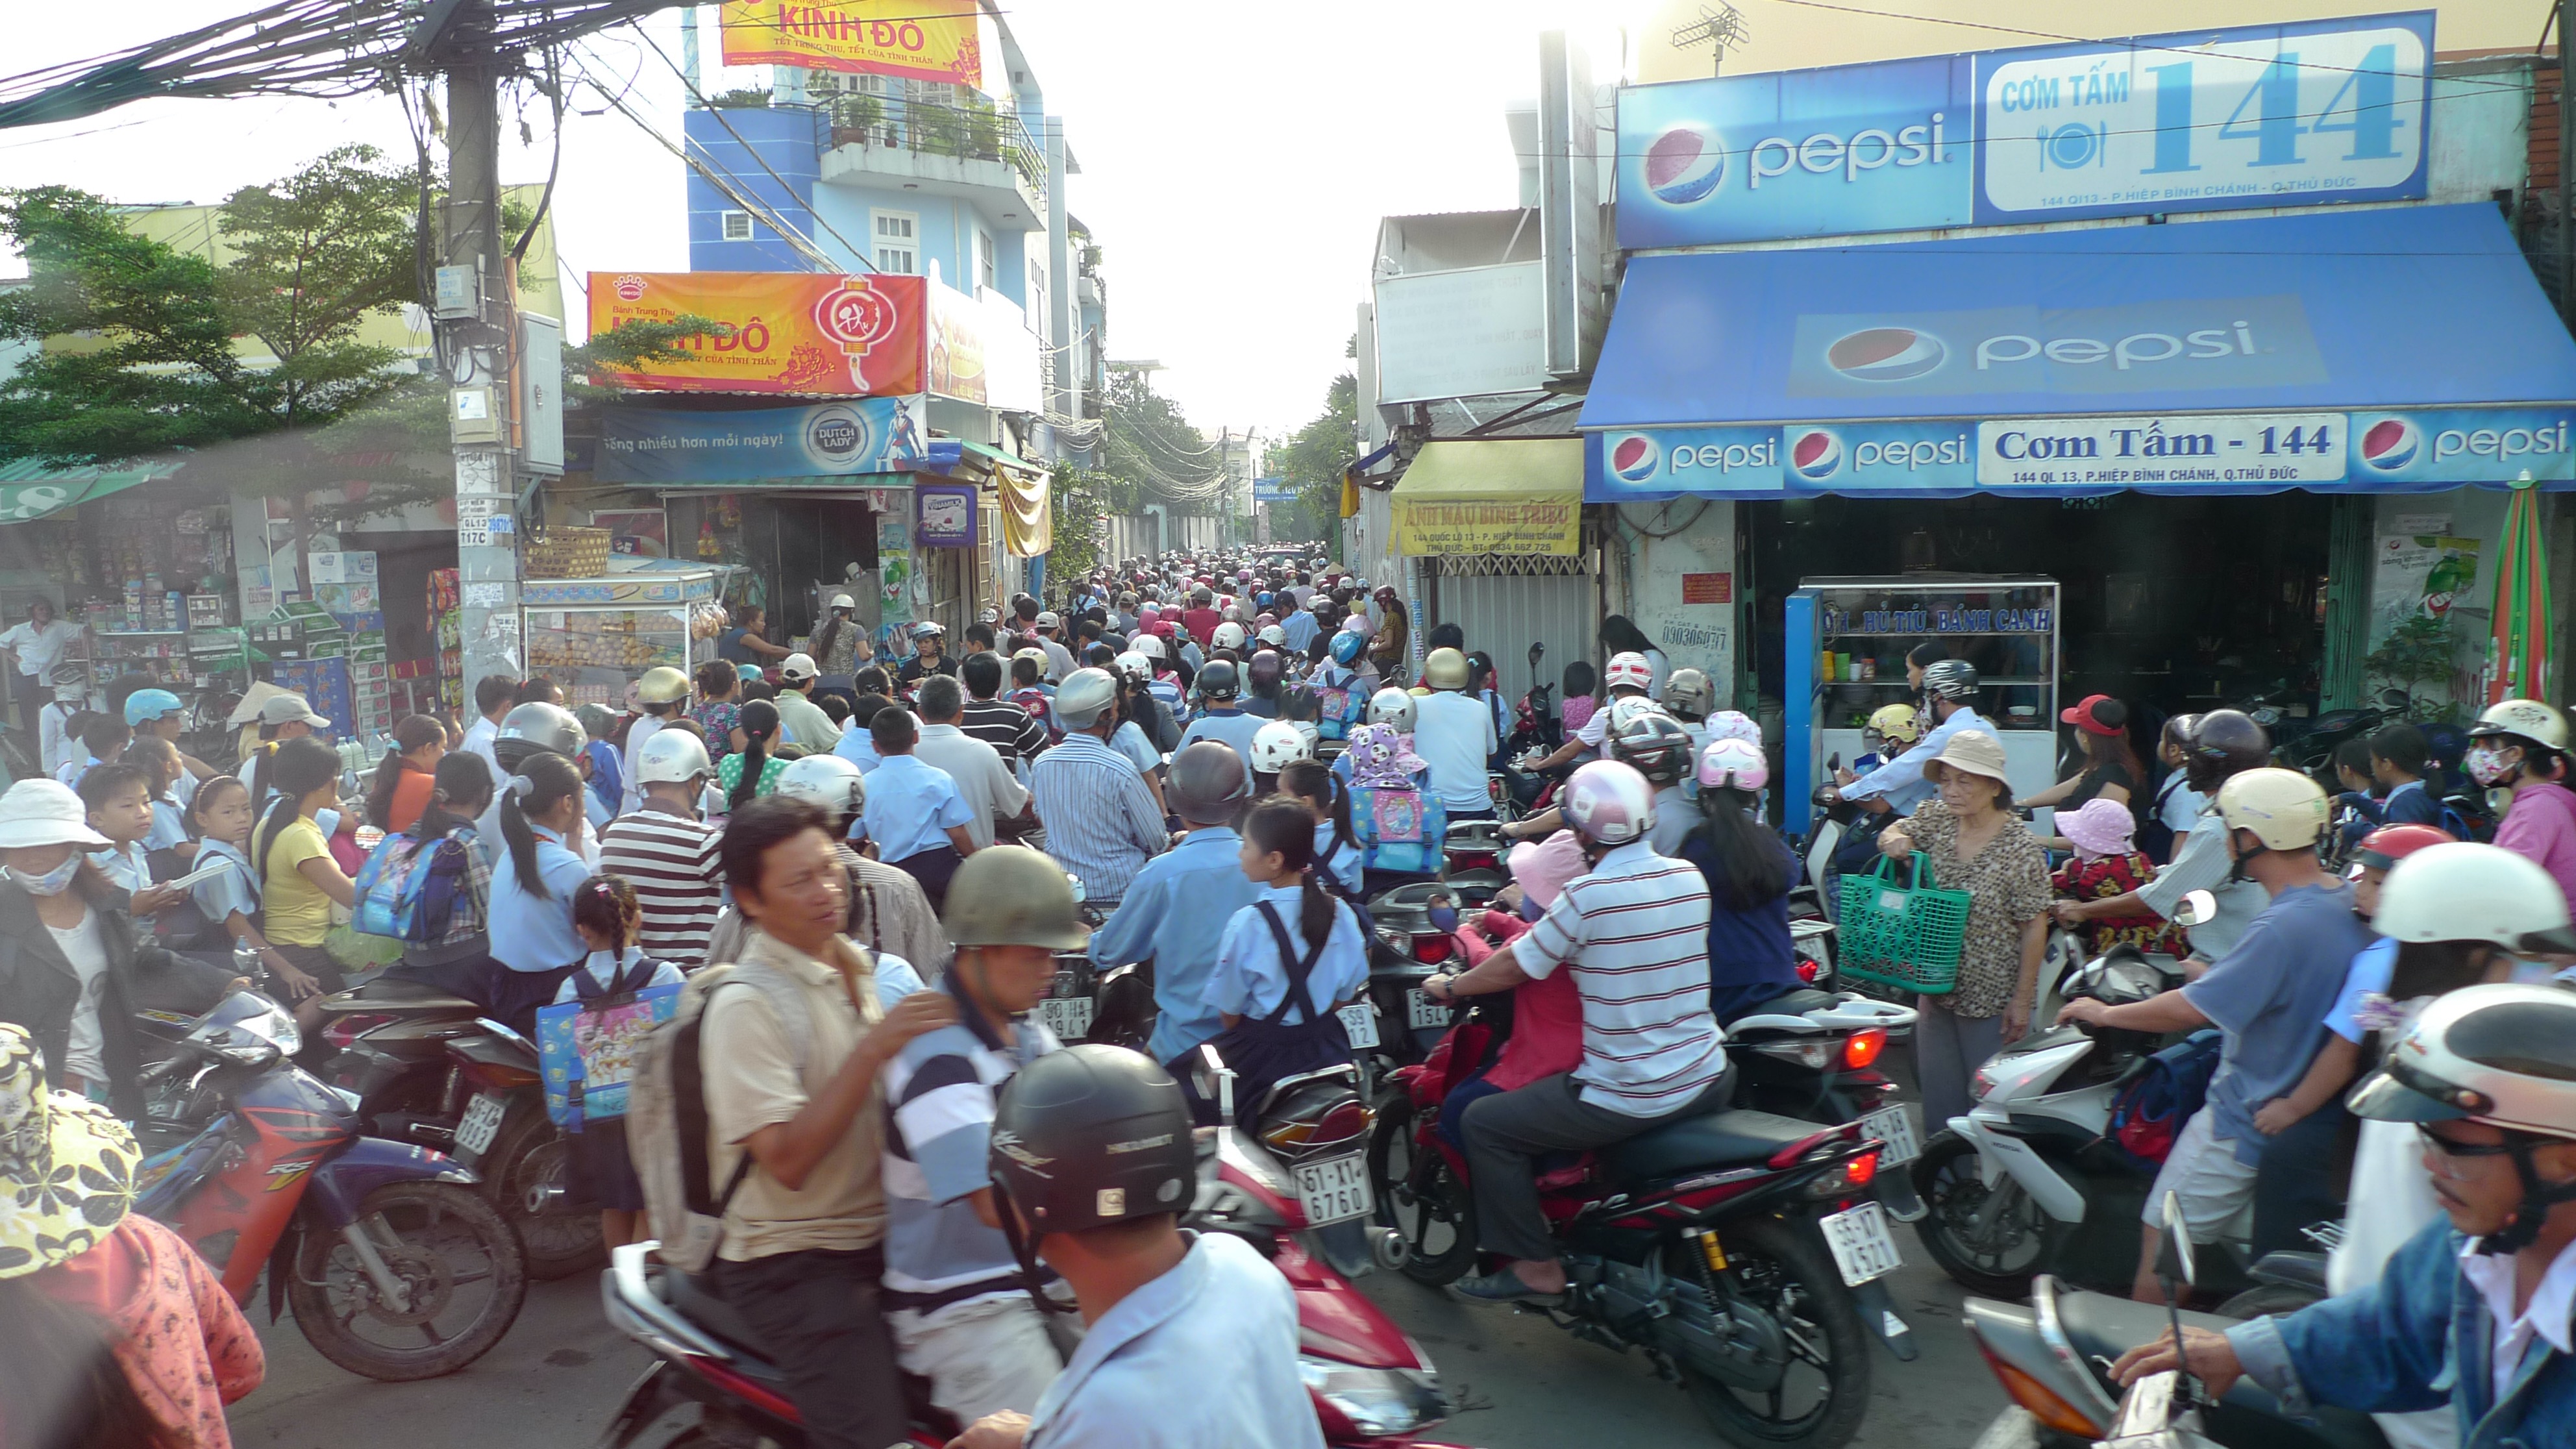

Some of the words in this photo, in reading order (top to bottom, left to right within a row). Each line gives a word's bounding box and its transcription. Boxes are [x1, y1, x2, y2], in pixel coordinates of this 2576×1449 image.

[779, 5, 863, 42] KINH
[870, 18, 924, 52] ĐÔ
[774, 37, 790, 46] TẾT
[793, 40, 823, 50] TRUNG
[825, 43, 845, 55] THU,
[848, 43, 865, 55] TẾT
[887, 50, 908, 62] TÌNH
[2000, 73, 2059, 113] CƠM
[2069, 60, 2129, 106] TẤM
[2140, 43, 2406, 175] 144
[1750, 112, 1944, 189] pepsi
[2040, 196, 2063, 207] 144
[2112, 189, 2160, 203] P.HIỆP
[2165, 186, 2199, 199] BÌNH
[2204, 182, 2257, 195] CHÁNH
[2323, 175, 2357, 188] ĐỨC
[613, 306, 633, 314] Bánh
[636, 307, 658, 317] Trung
[660, 308, 675, 316] Thu
[1977, 320, 2256, 370] pepsi
[705, 354, 724, 364] CỦA
[726, 355, 749, 365] TÌNH
[638, 433, 676, 449] nhiều
[680, 436, 708, 448] hơn
[713, 432, 739, 447] mỗi
[743, 433, 783, 449] ngày!
[819, 427, 855, 440] DUTCH
[824, 437, 852, 448] LADY
[1996, 430, 2103, 462] Cơm
[2111, 420, 2216, 458] Tấm
[2259, 426, 2331, 456] 144
[2433, 421, 2566, 462] pepsi
[1669, 438, 1777, 475] pepsi
[1853, 434, 1966, 472] pepsi
[2012, 471, 2037, 484] 144
[2040, 471, 2057, 485] QL
[2061, 470, 2081, 484] 13,
[2085, 466, 2131, 484] P.HIỆP
[2133, 465, 2168, 482] BÌNH
[2172, 465, 2220, 482] CHÁNH,
[2224, 463, 2266, 482] Q.THỦ
[2269, 464, 2299, 480] ĐỨC
[928, 499, 961, 510] VINAMILK
[464, 519, 487, 528] QL13
[460, 532, 486, 544] T17C
[1430, 532, 1451, 542] QUỐC
[1465, 533, 1474, 541] 13
[1483, 533, 1491, 541] P.
[1489, 542, 1511, 552] 0934
[1515, 543, 1532, 552] 662
[1535, 543, 1552, 551] 726
[1863, 601, 1890, 633] HỦ
[1893, 604, 1927, 634] TIÚ
[1937, 603, 1991, 633] BÁNH
[1995, 608, 2051, 633] CANH
[1310, 1187, 1363, 1220] 6760
